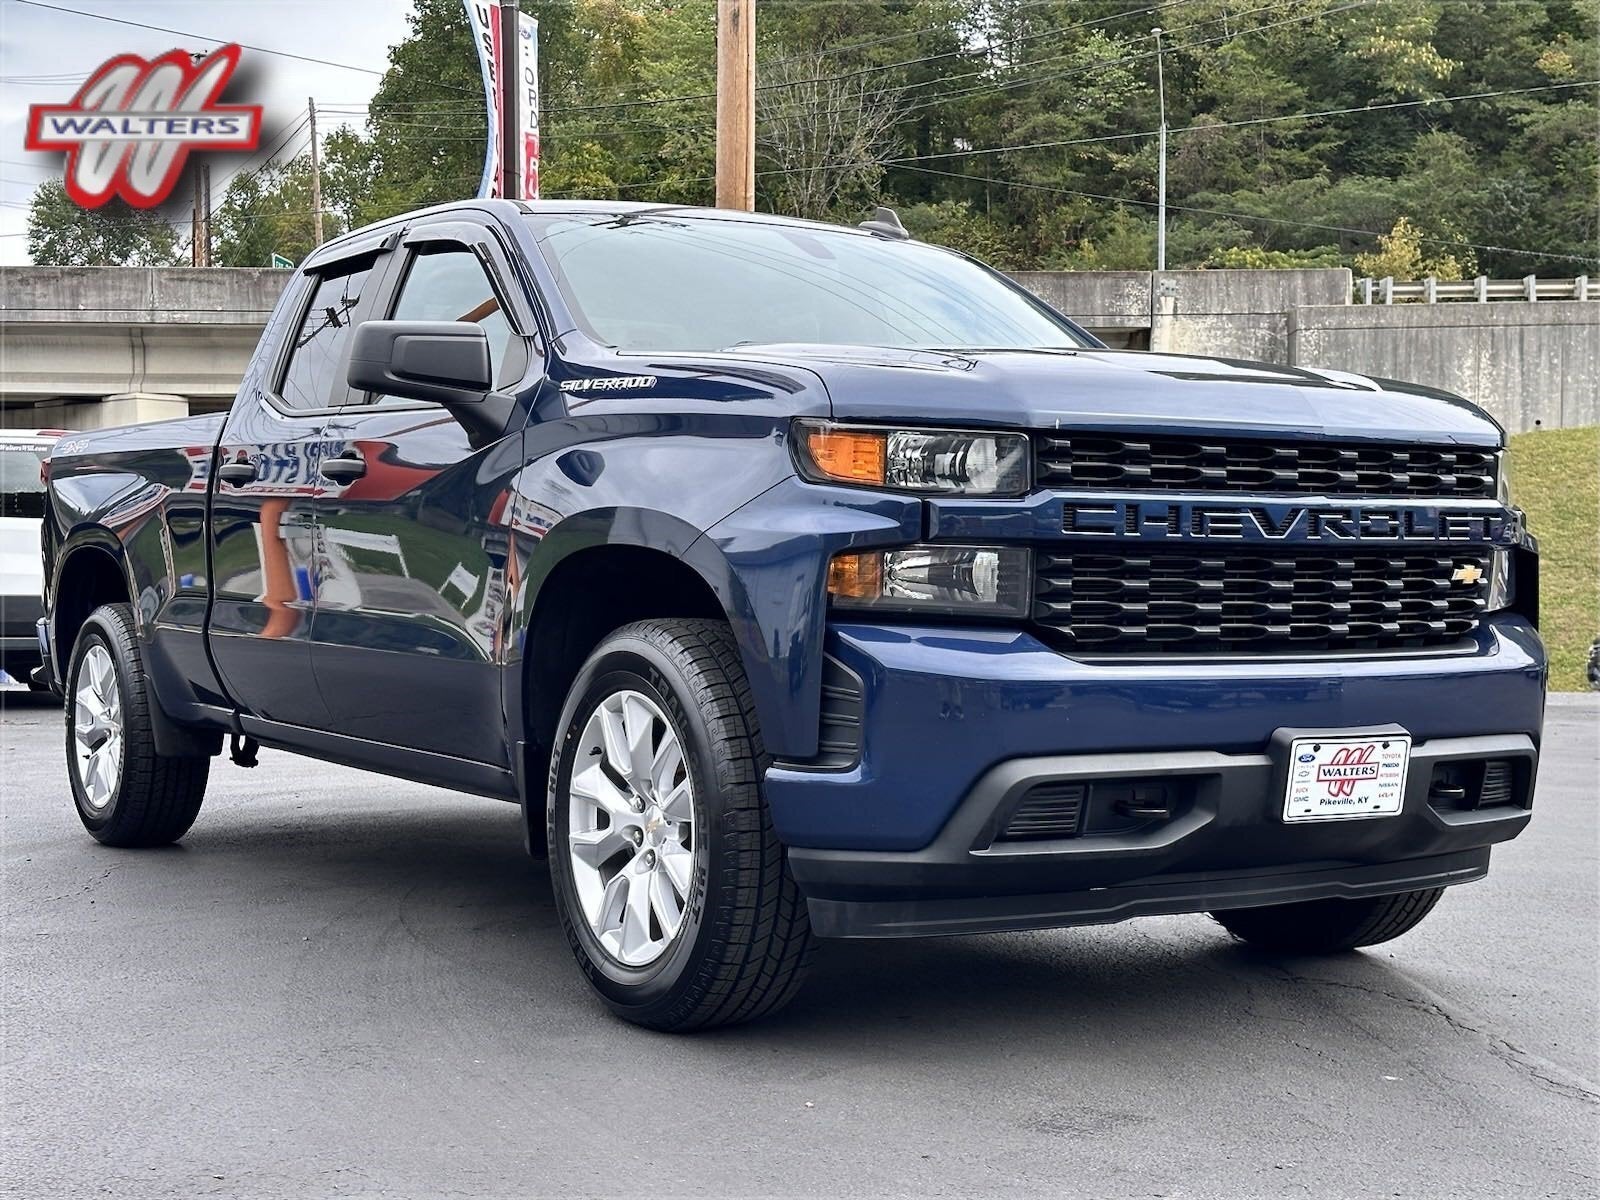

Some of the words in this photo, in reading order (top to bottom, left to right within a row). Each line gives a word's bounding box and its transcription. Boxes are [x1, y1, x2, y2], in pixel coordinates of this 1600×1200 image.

[559, 376, 656, 392] SILVERADO
[1061, 502, 1504, 542] CHEVROLET
[1322, 765, 1376, 777] WALTERS
[1319, 798, 1355, 806] Pikeville,
[1357, 796, 1369, 804] KY
